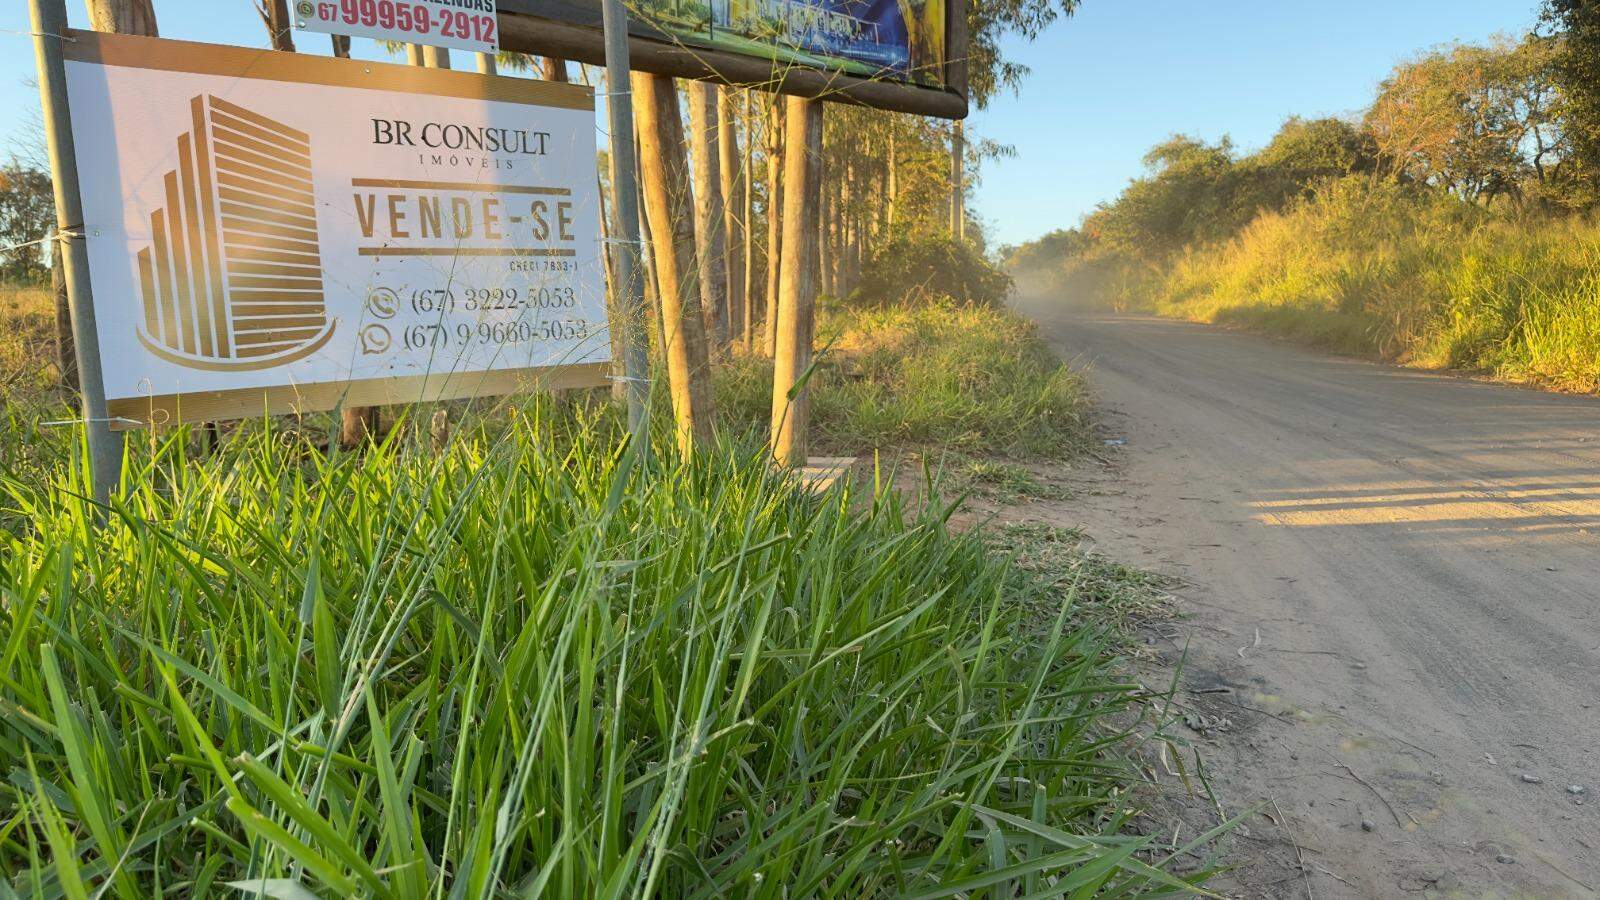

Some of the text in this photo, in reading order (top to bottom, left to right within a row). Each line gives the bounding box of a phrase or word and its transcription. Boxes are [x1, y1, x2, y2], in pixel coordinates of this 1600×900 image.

[317, 0, 495, 44] 67 99959-2912
[372, 118, 550, 156] BR CONSULT
[419, 154, 513, 170] IMÓVEIS
[353, 193, 575, 241] VENDE-SE
[411, 286, 574, 315] (67) 3222-5053
[404, 323, 448, 351] (67)
